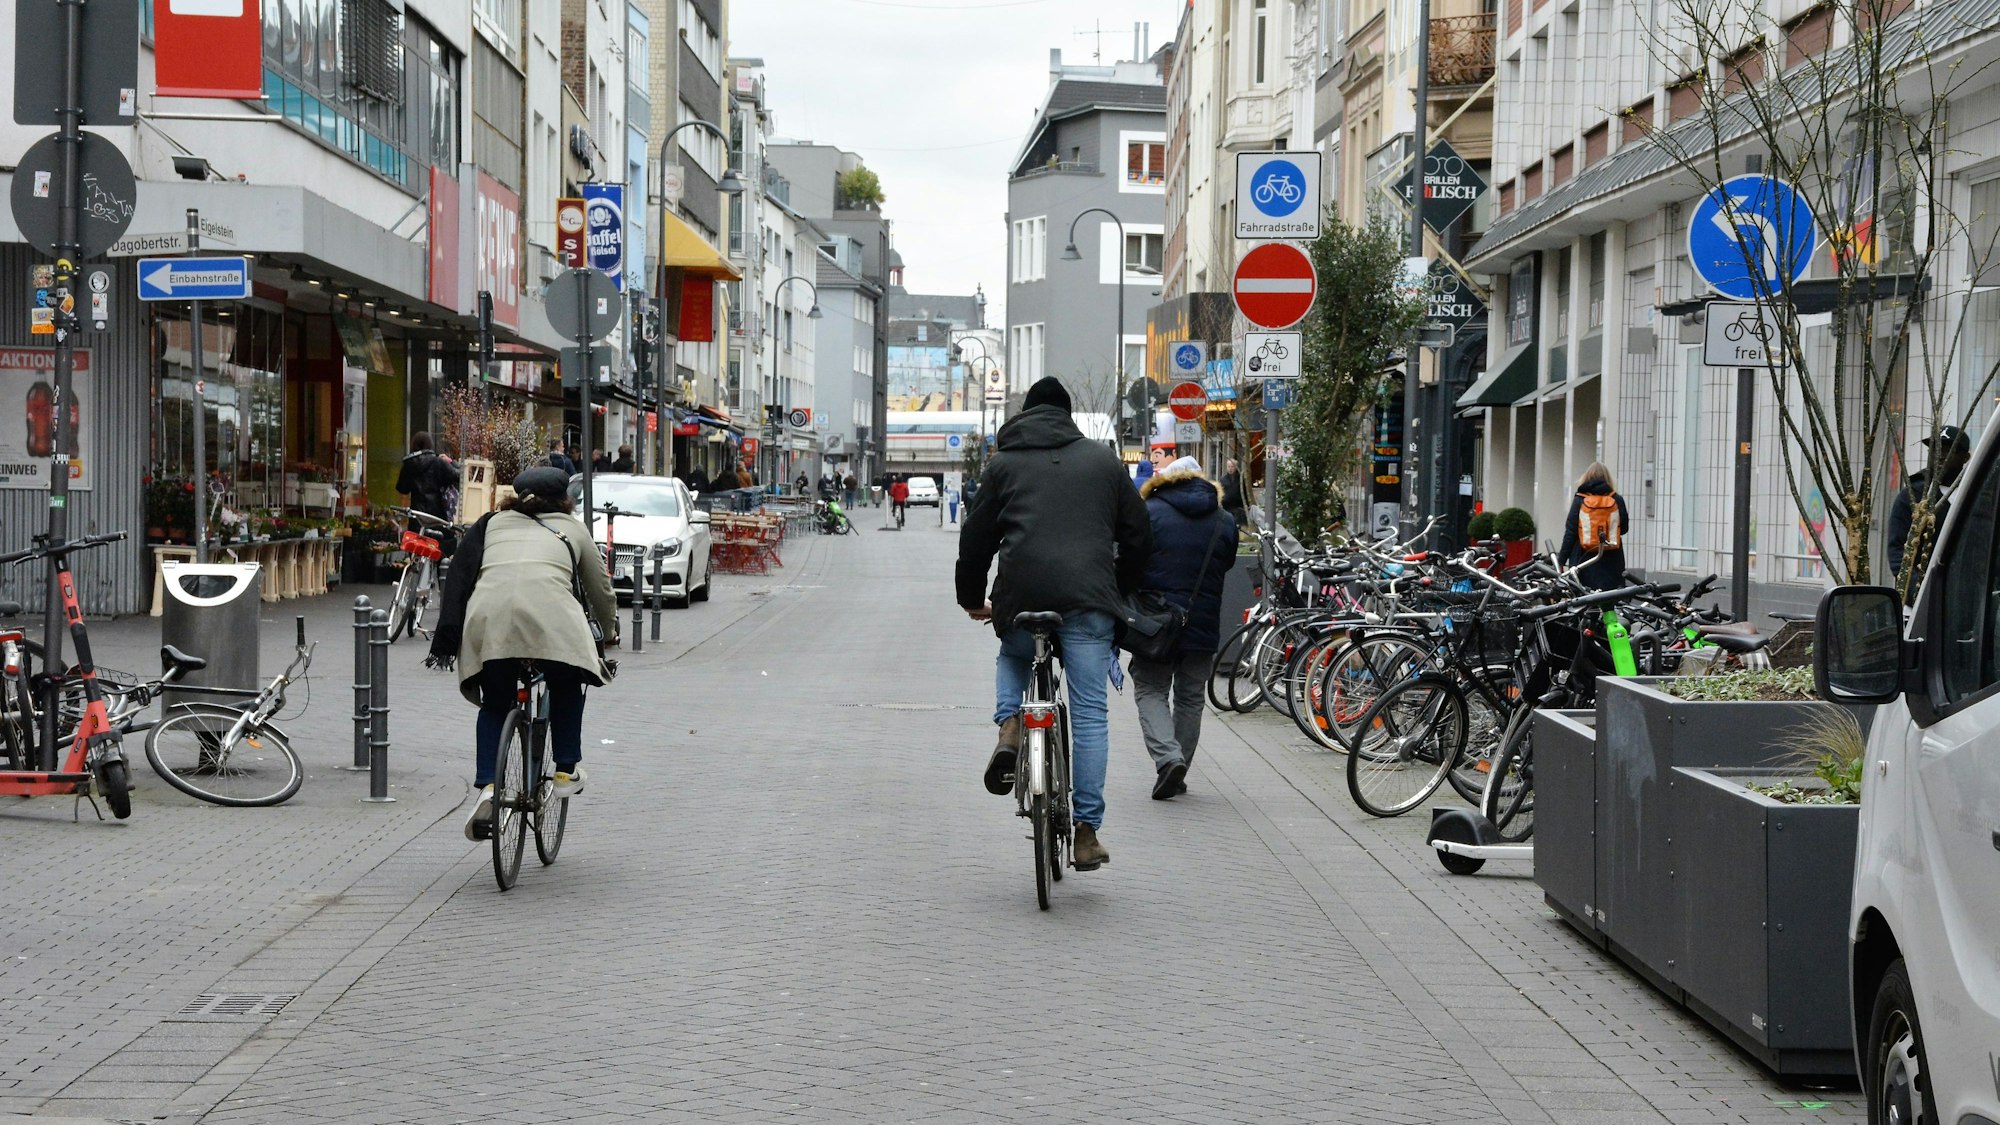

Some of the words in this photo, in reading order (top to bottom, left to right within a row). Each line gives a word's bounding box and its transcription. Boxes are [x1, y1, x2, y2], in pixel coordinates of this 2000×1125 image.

[1424, 176, 1460, 185] BRILLEN
[200, 217, 234, 239] Eigelstein
[1240, 222, 1315, 232] Fahrradstraße
[111, 236, 182, 254] Dagobertstr.
[478, 191, 517, 306] REWE
[169, 273, 240, 284] Einbahnstraße
[1735, 345, 1762, 359] frei
[0, 352, 56, 368] AKTION
[1263, 362, 1281, 372] frei
